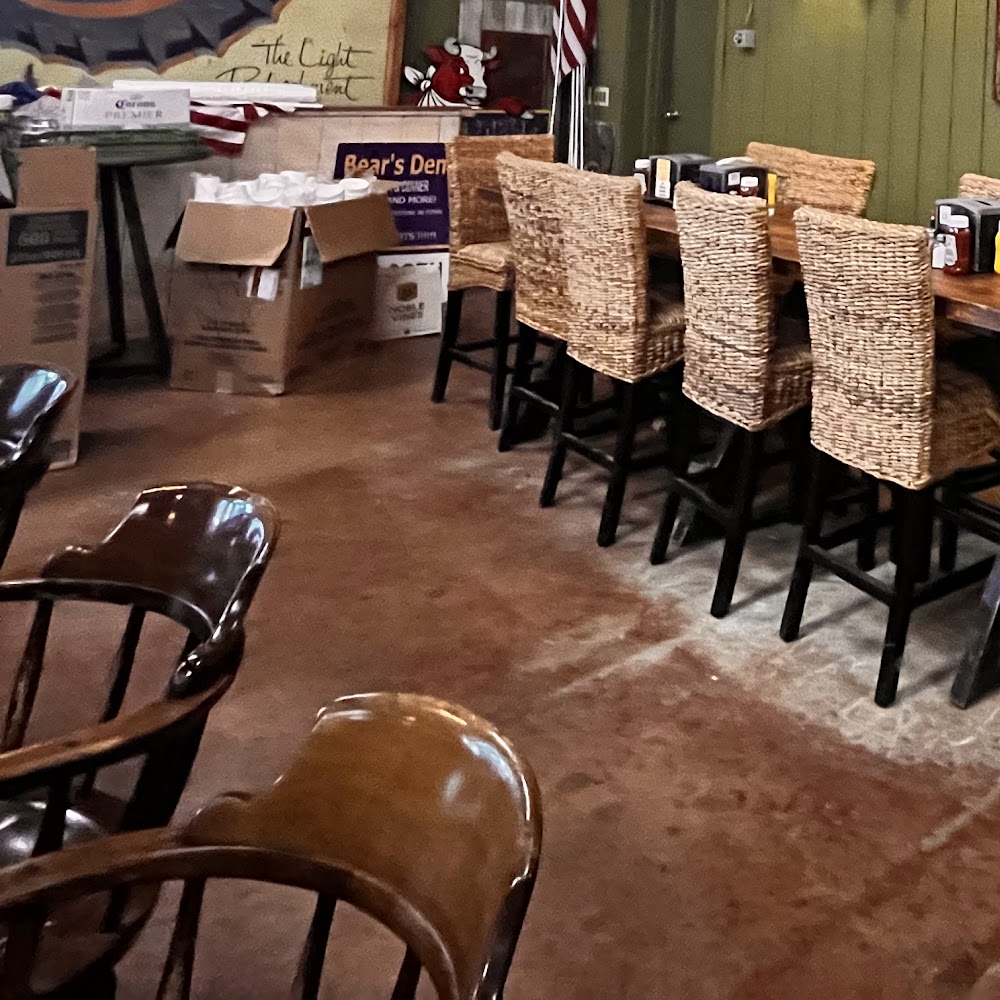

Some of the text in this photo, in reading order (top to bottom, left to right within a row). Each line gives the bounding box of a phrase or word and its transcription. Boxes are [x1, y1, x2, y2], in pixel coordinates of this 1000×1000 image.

[251, 34, 373, 77] The Light
[115, 98, 156, 110] Corona
[104, 110, 163, 120] PREMIER
[344, 153, 447, 177] Bear's Den
